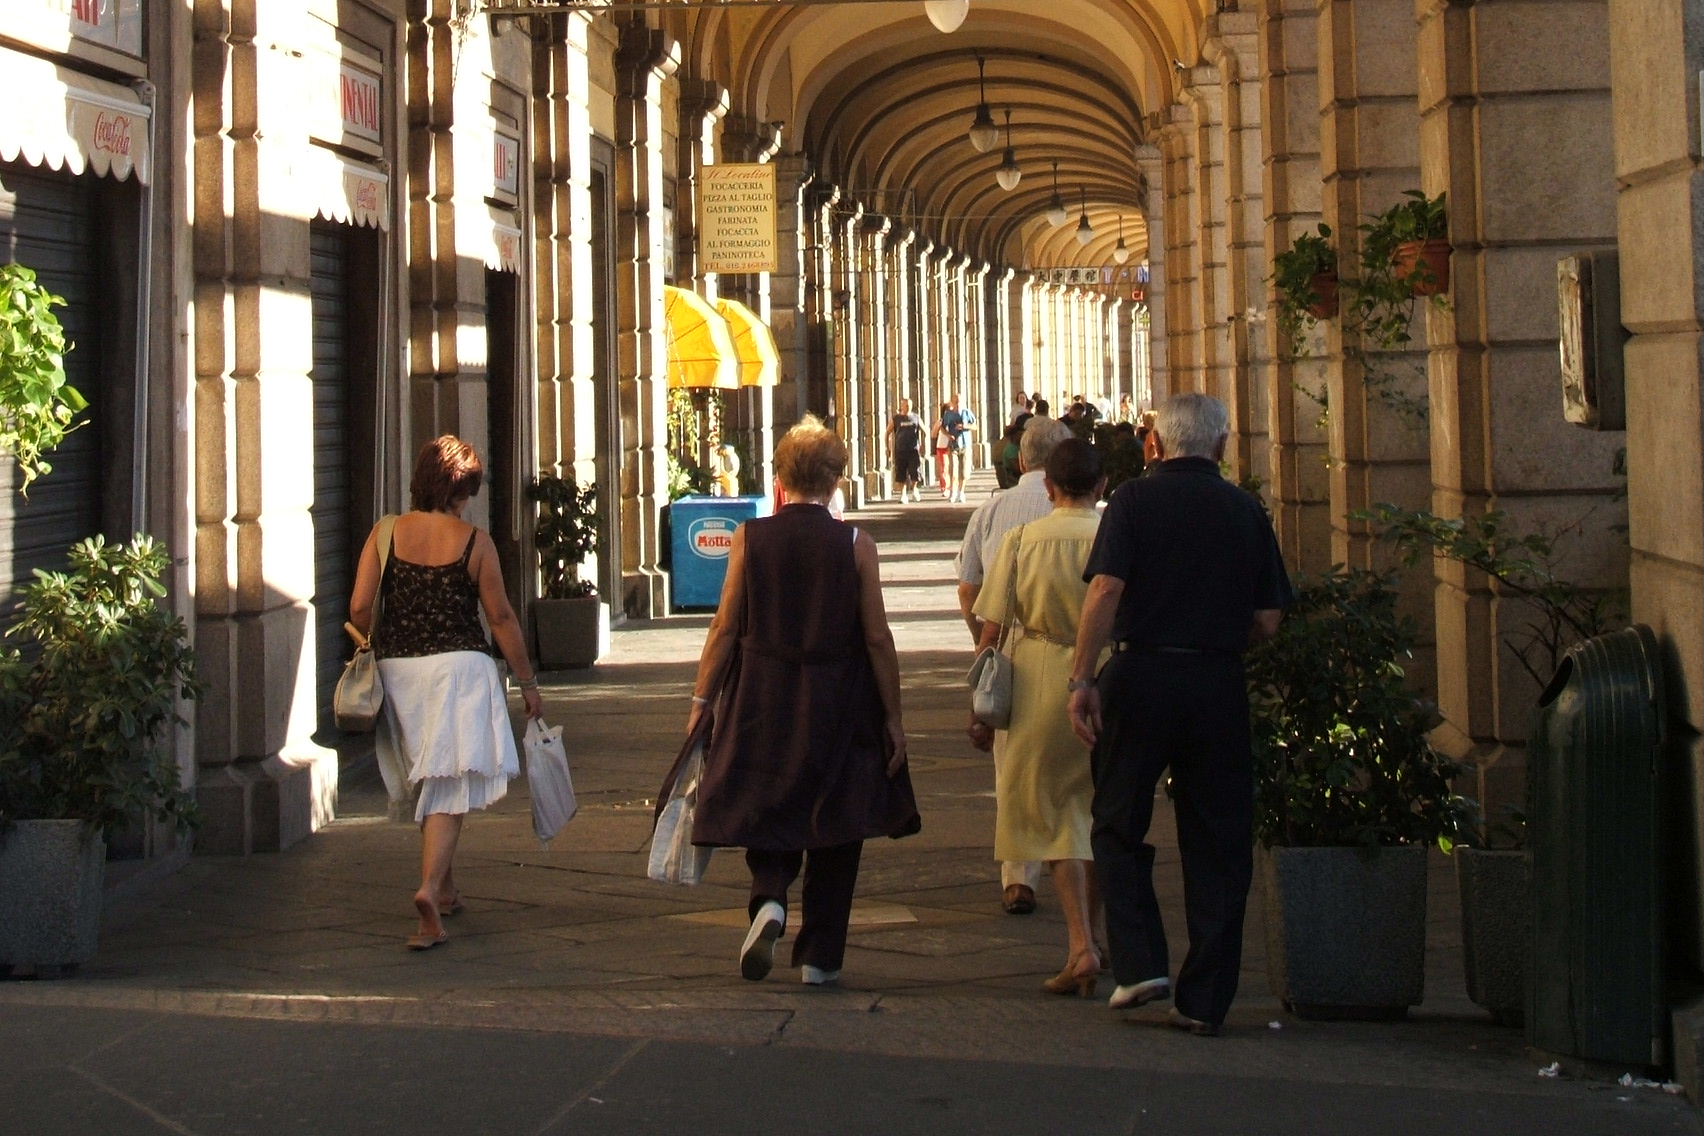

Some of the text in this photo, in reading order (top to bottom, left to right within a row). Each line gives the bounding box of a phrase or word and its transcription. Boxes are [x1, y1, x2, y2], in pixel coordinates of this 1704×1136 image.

[711, 182, 763, 191] FOCACCERIA
[729, 194, 739, 202] AL
[742, 193, 772, 201] TAGLIO
[706, 205, 768, 214] GASTRONOMIA
[718, 216, 758, 224] FARINATA
[717, 228, 759, 236] FOCACCIA
[719, 240, 771, 248] FORMAGGIO
[712, 251, 765, 259] PANINOTECA
[698, 536, 731, 547] Motta
